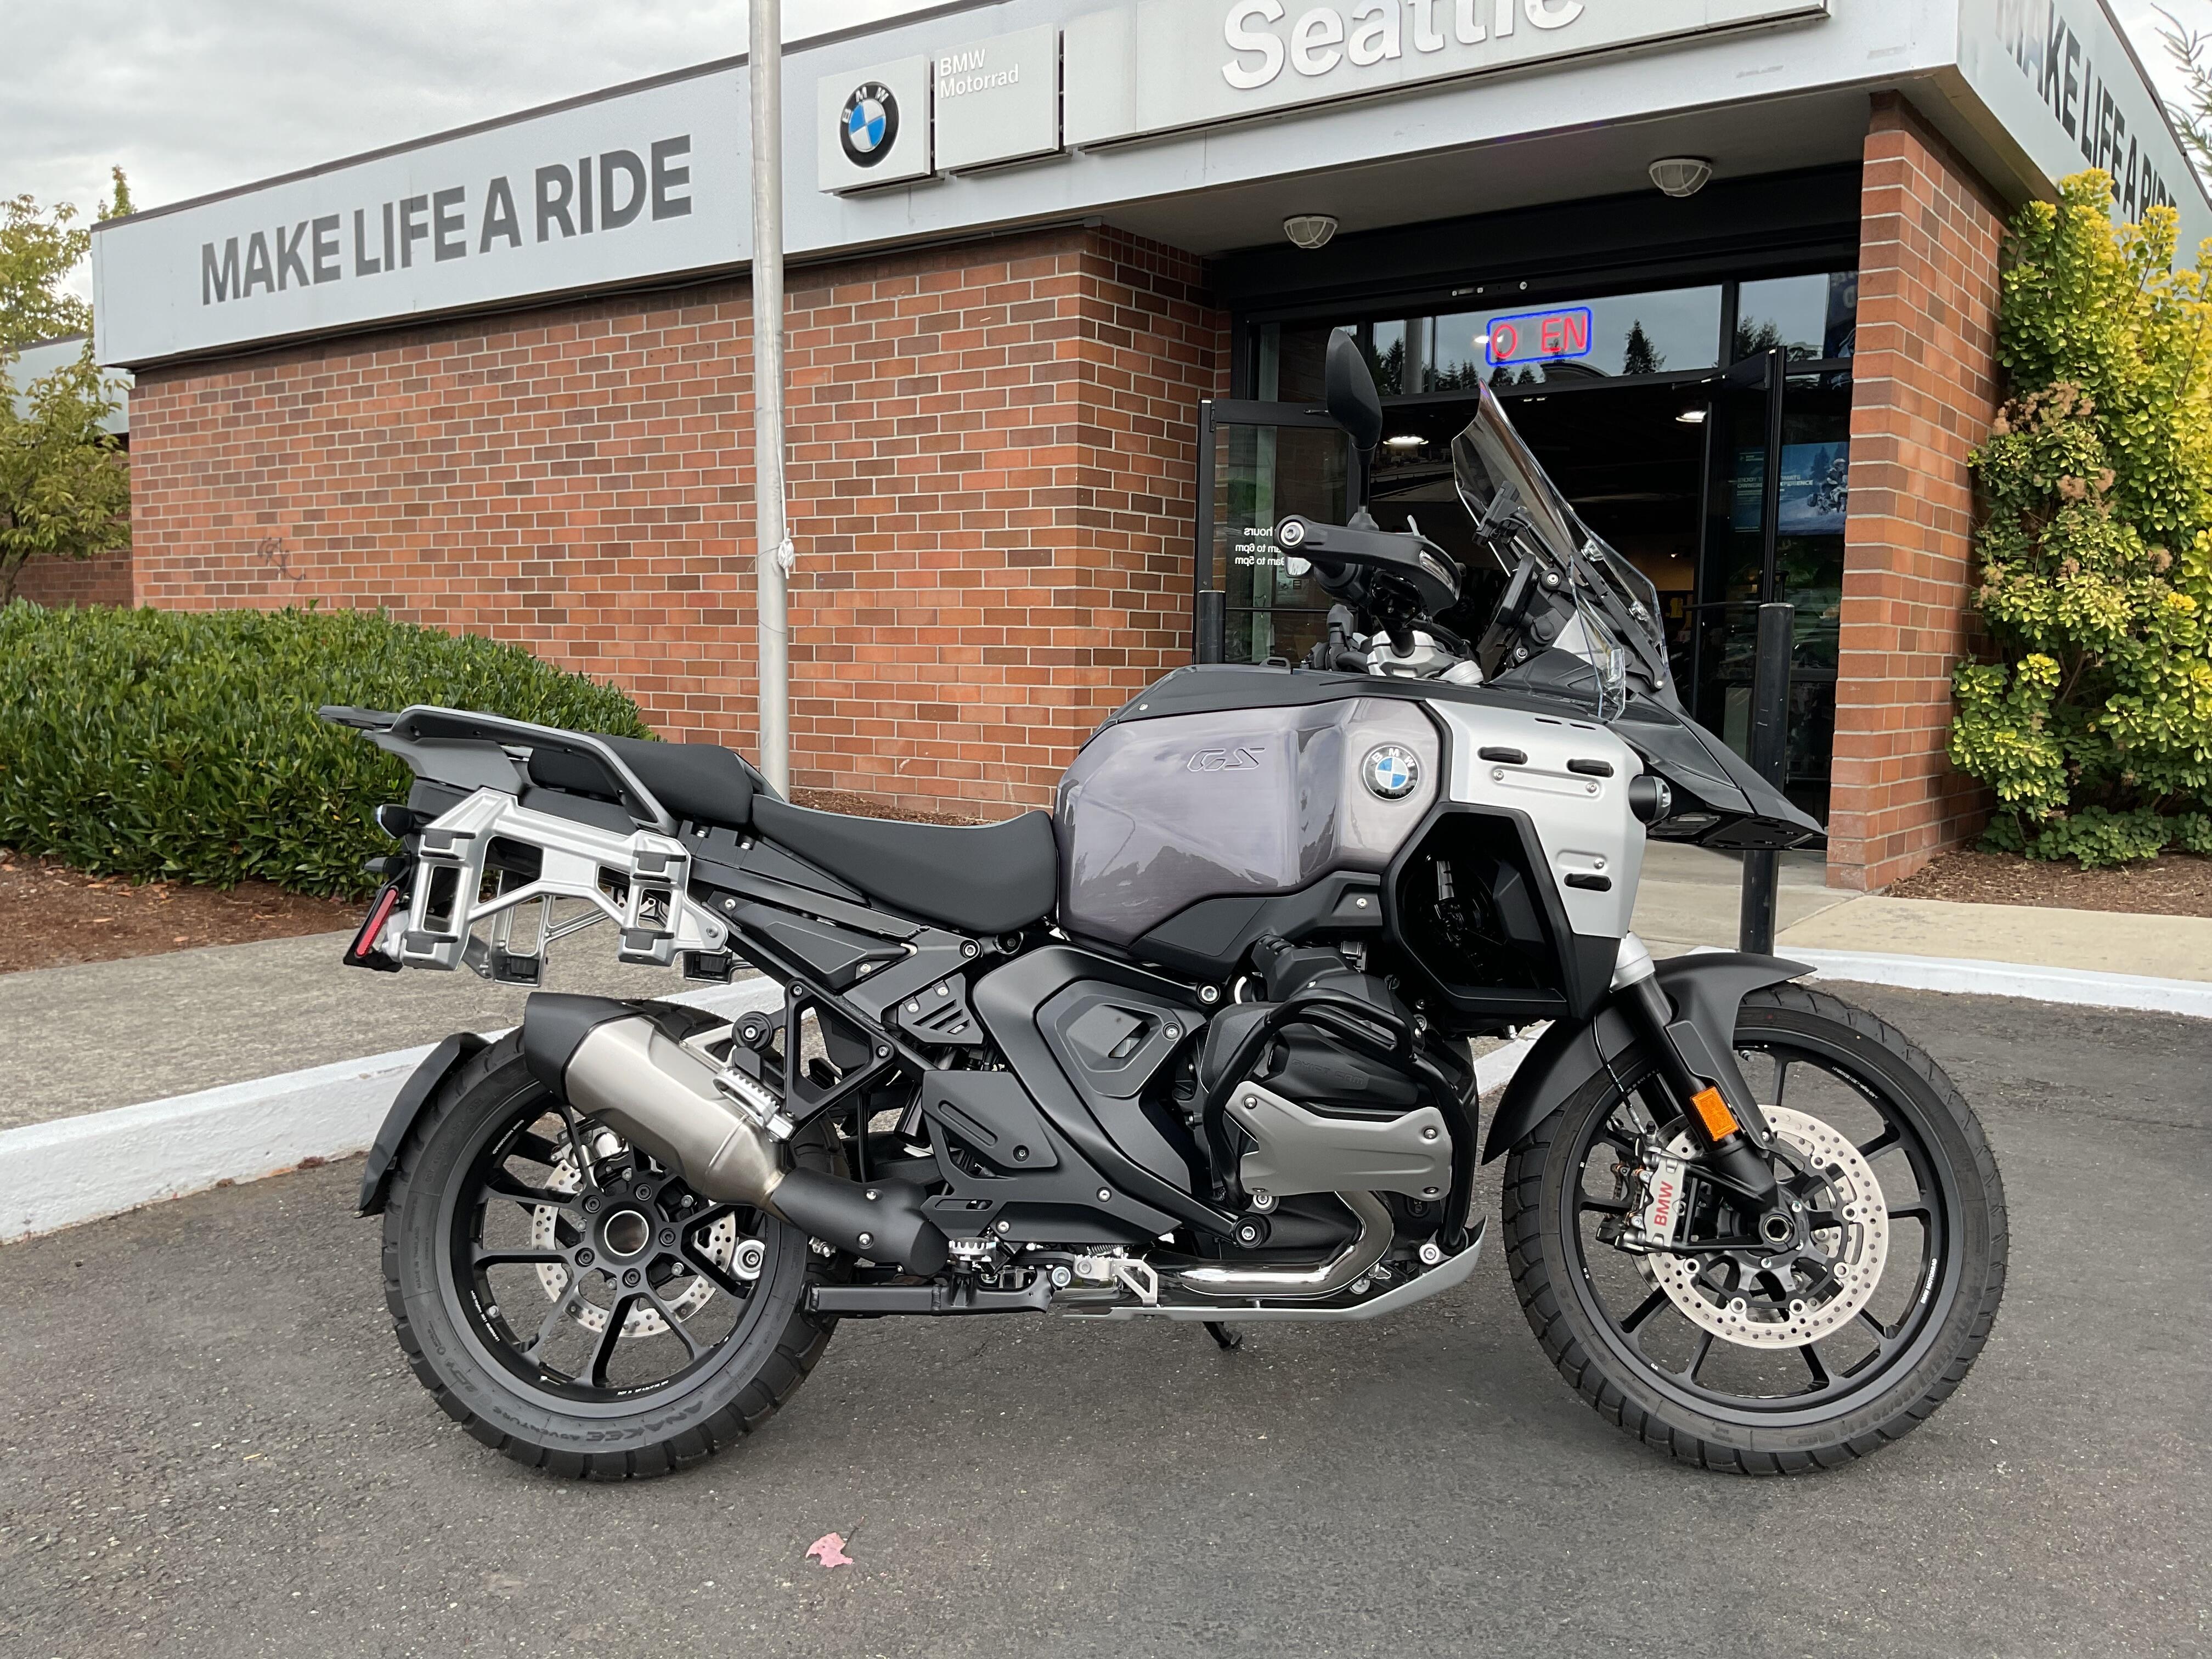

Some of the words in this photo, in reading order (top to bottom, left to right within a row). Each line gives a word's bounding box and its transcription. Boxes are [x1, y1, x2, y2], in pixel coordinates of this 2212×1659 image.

[940, 48, 986, 77] BMW
[941, 63, 1019, 99] Motorrad
[842, 86, 889, 124] BMW
[2081, 57, 2125, 205] LIFE
[2123, 133, 2137, 225] A
[202, 215, 341, 305] MAKE
[355, 185, 467, 278] LIFE
[479, 176, 521, 253] A
[535, 134, 692, 242] RIDE
[1492, 314, 1587, 359] OEN
[1187, 747, 1266, 772] GS
[1372, 748, 1415, 768] BMW
[1654, 1181, 1673, 1227] BMW
[1920, 1289, 1929, 1304] BMW
[1926, 1258, 1937, 1290] MOTORRAD
